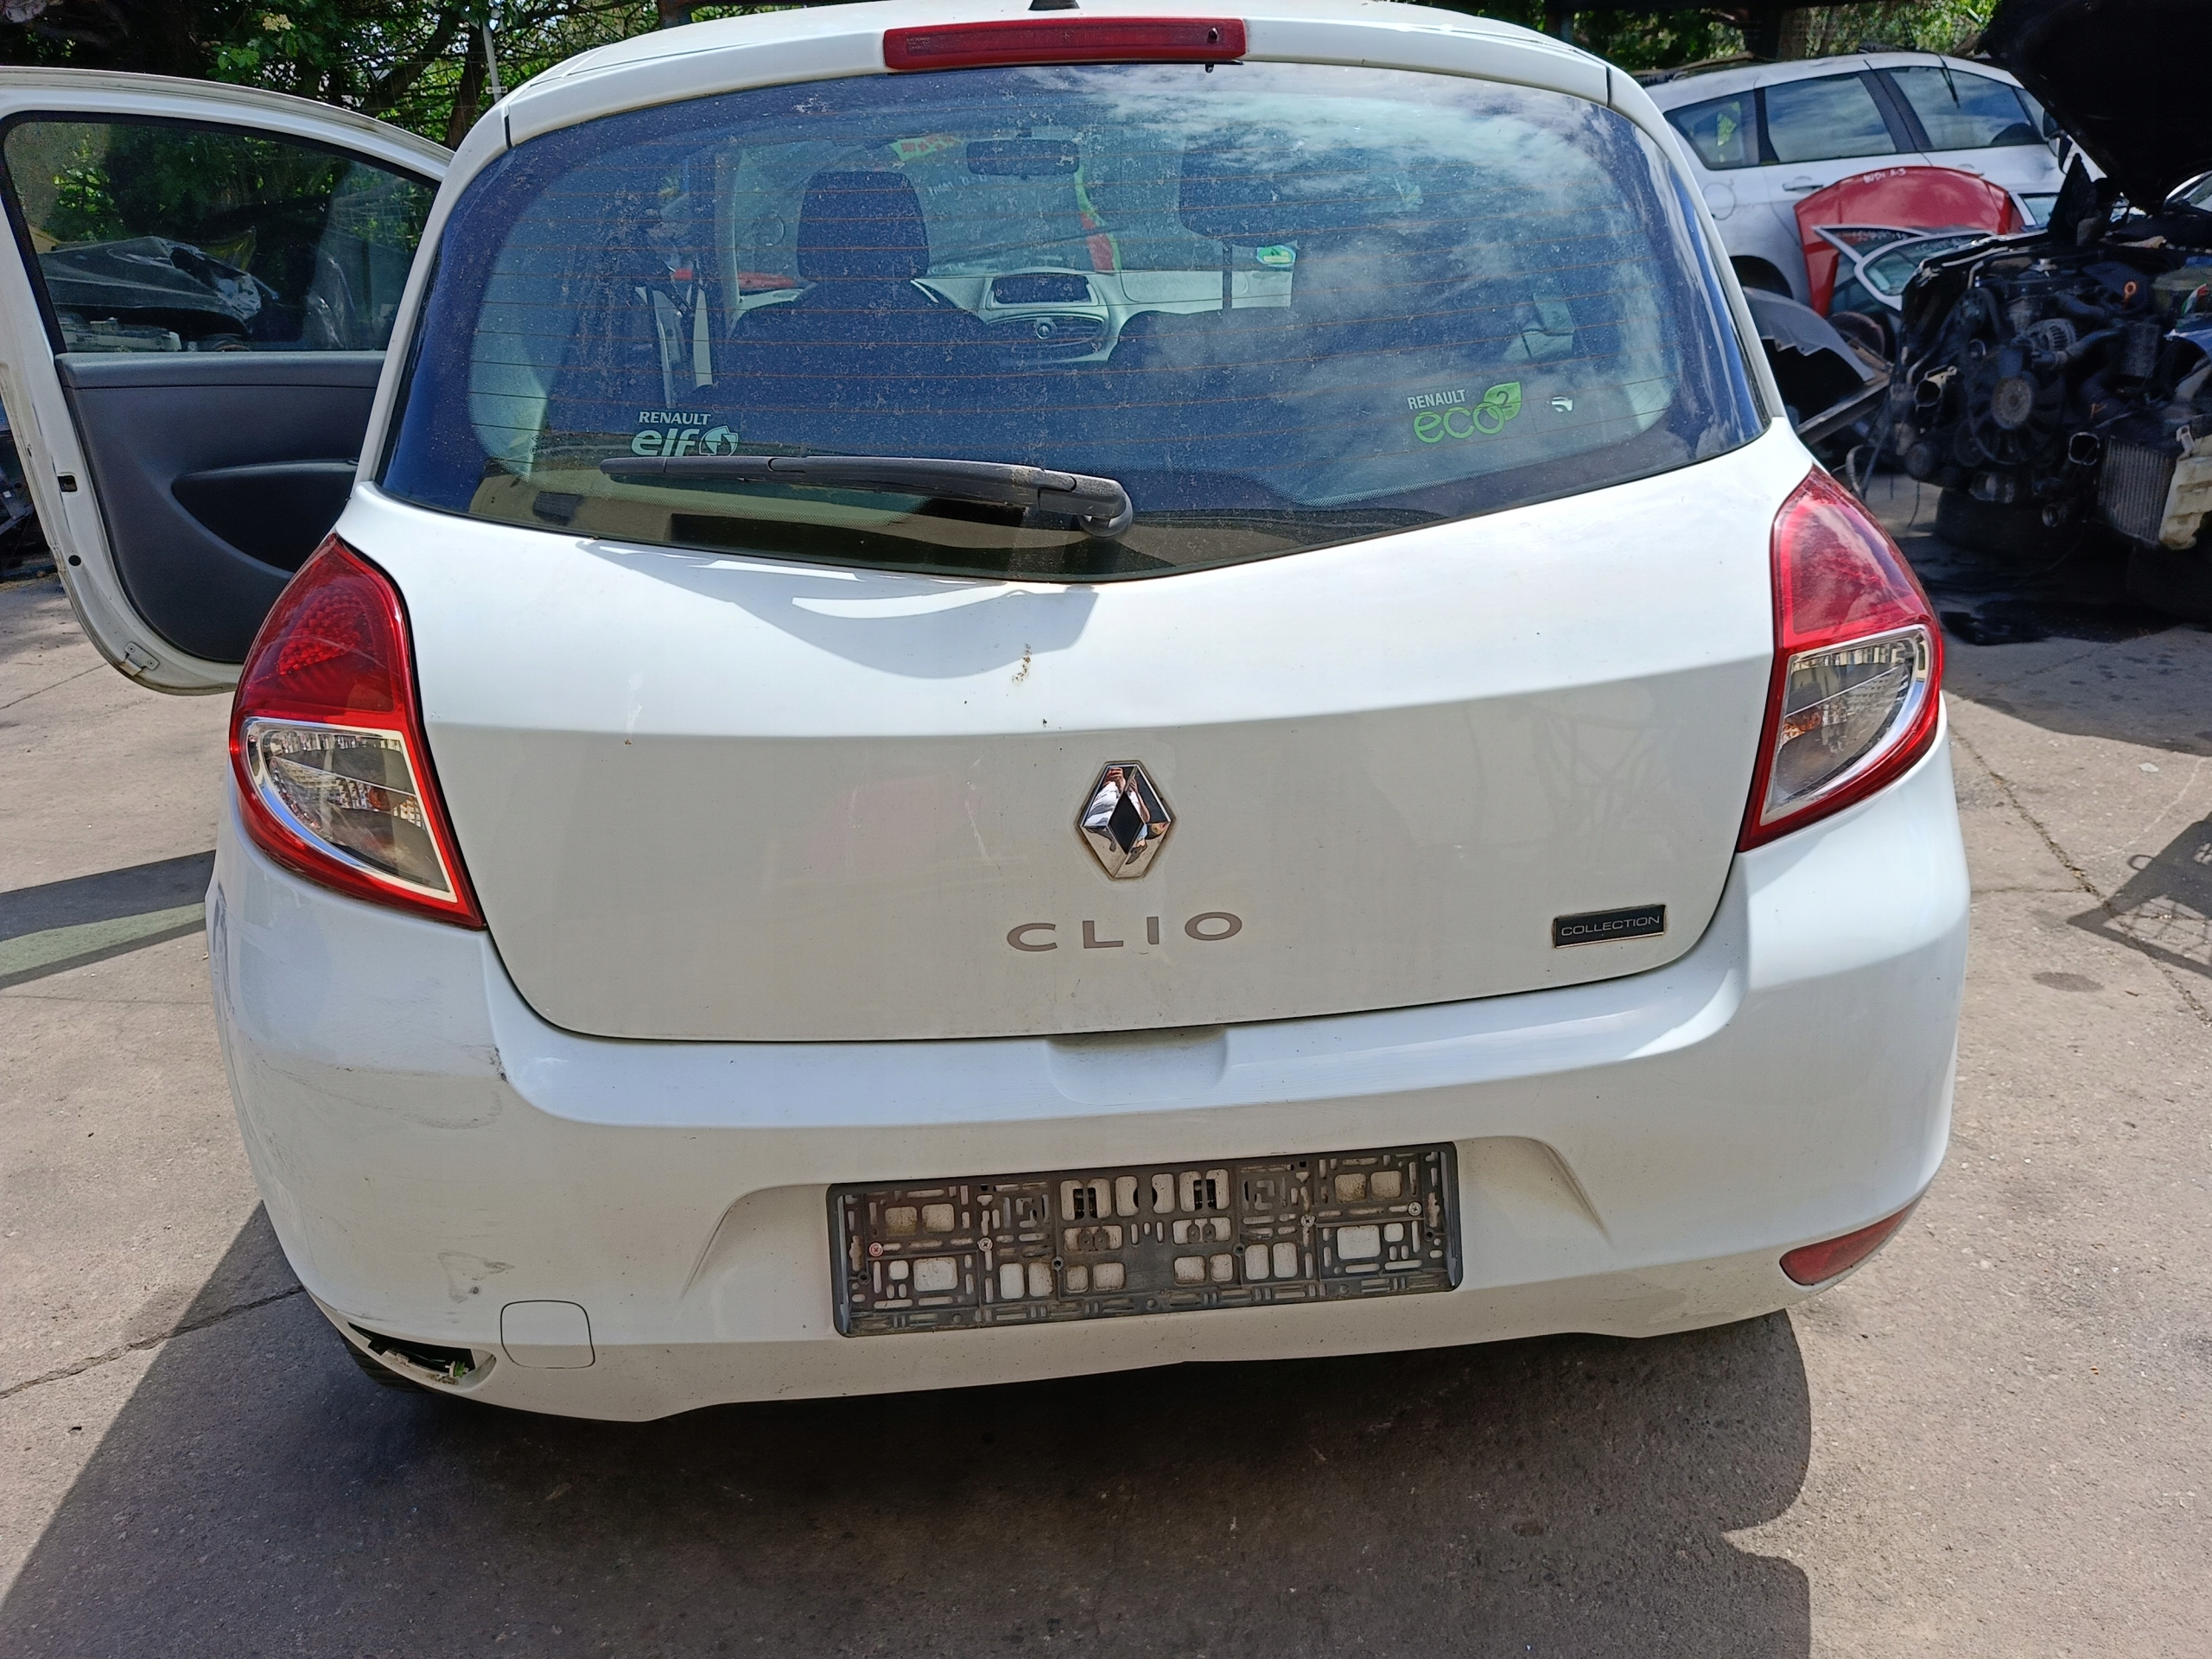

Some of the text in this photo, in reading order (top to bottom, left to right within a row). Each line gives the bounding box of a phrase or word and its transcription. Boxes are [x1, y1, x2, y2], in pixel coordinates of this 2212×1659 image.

[1407, 389, 1466, 410] RENAULT
[639, 410, 712, 425] RENAULT
[631, 428, 700, 457] elf
[1007, 912, 1243, 952] CLIO
[1560, 915, 1661, 937] COLLECTION
